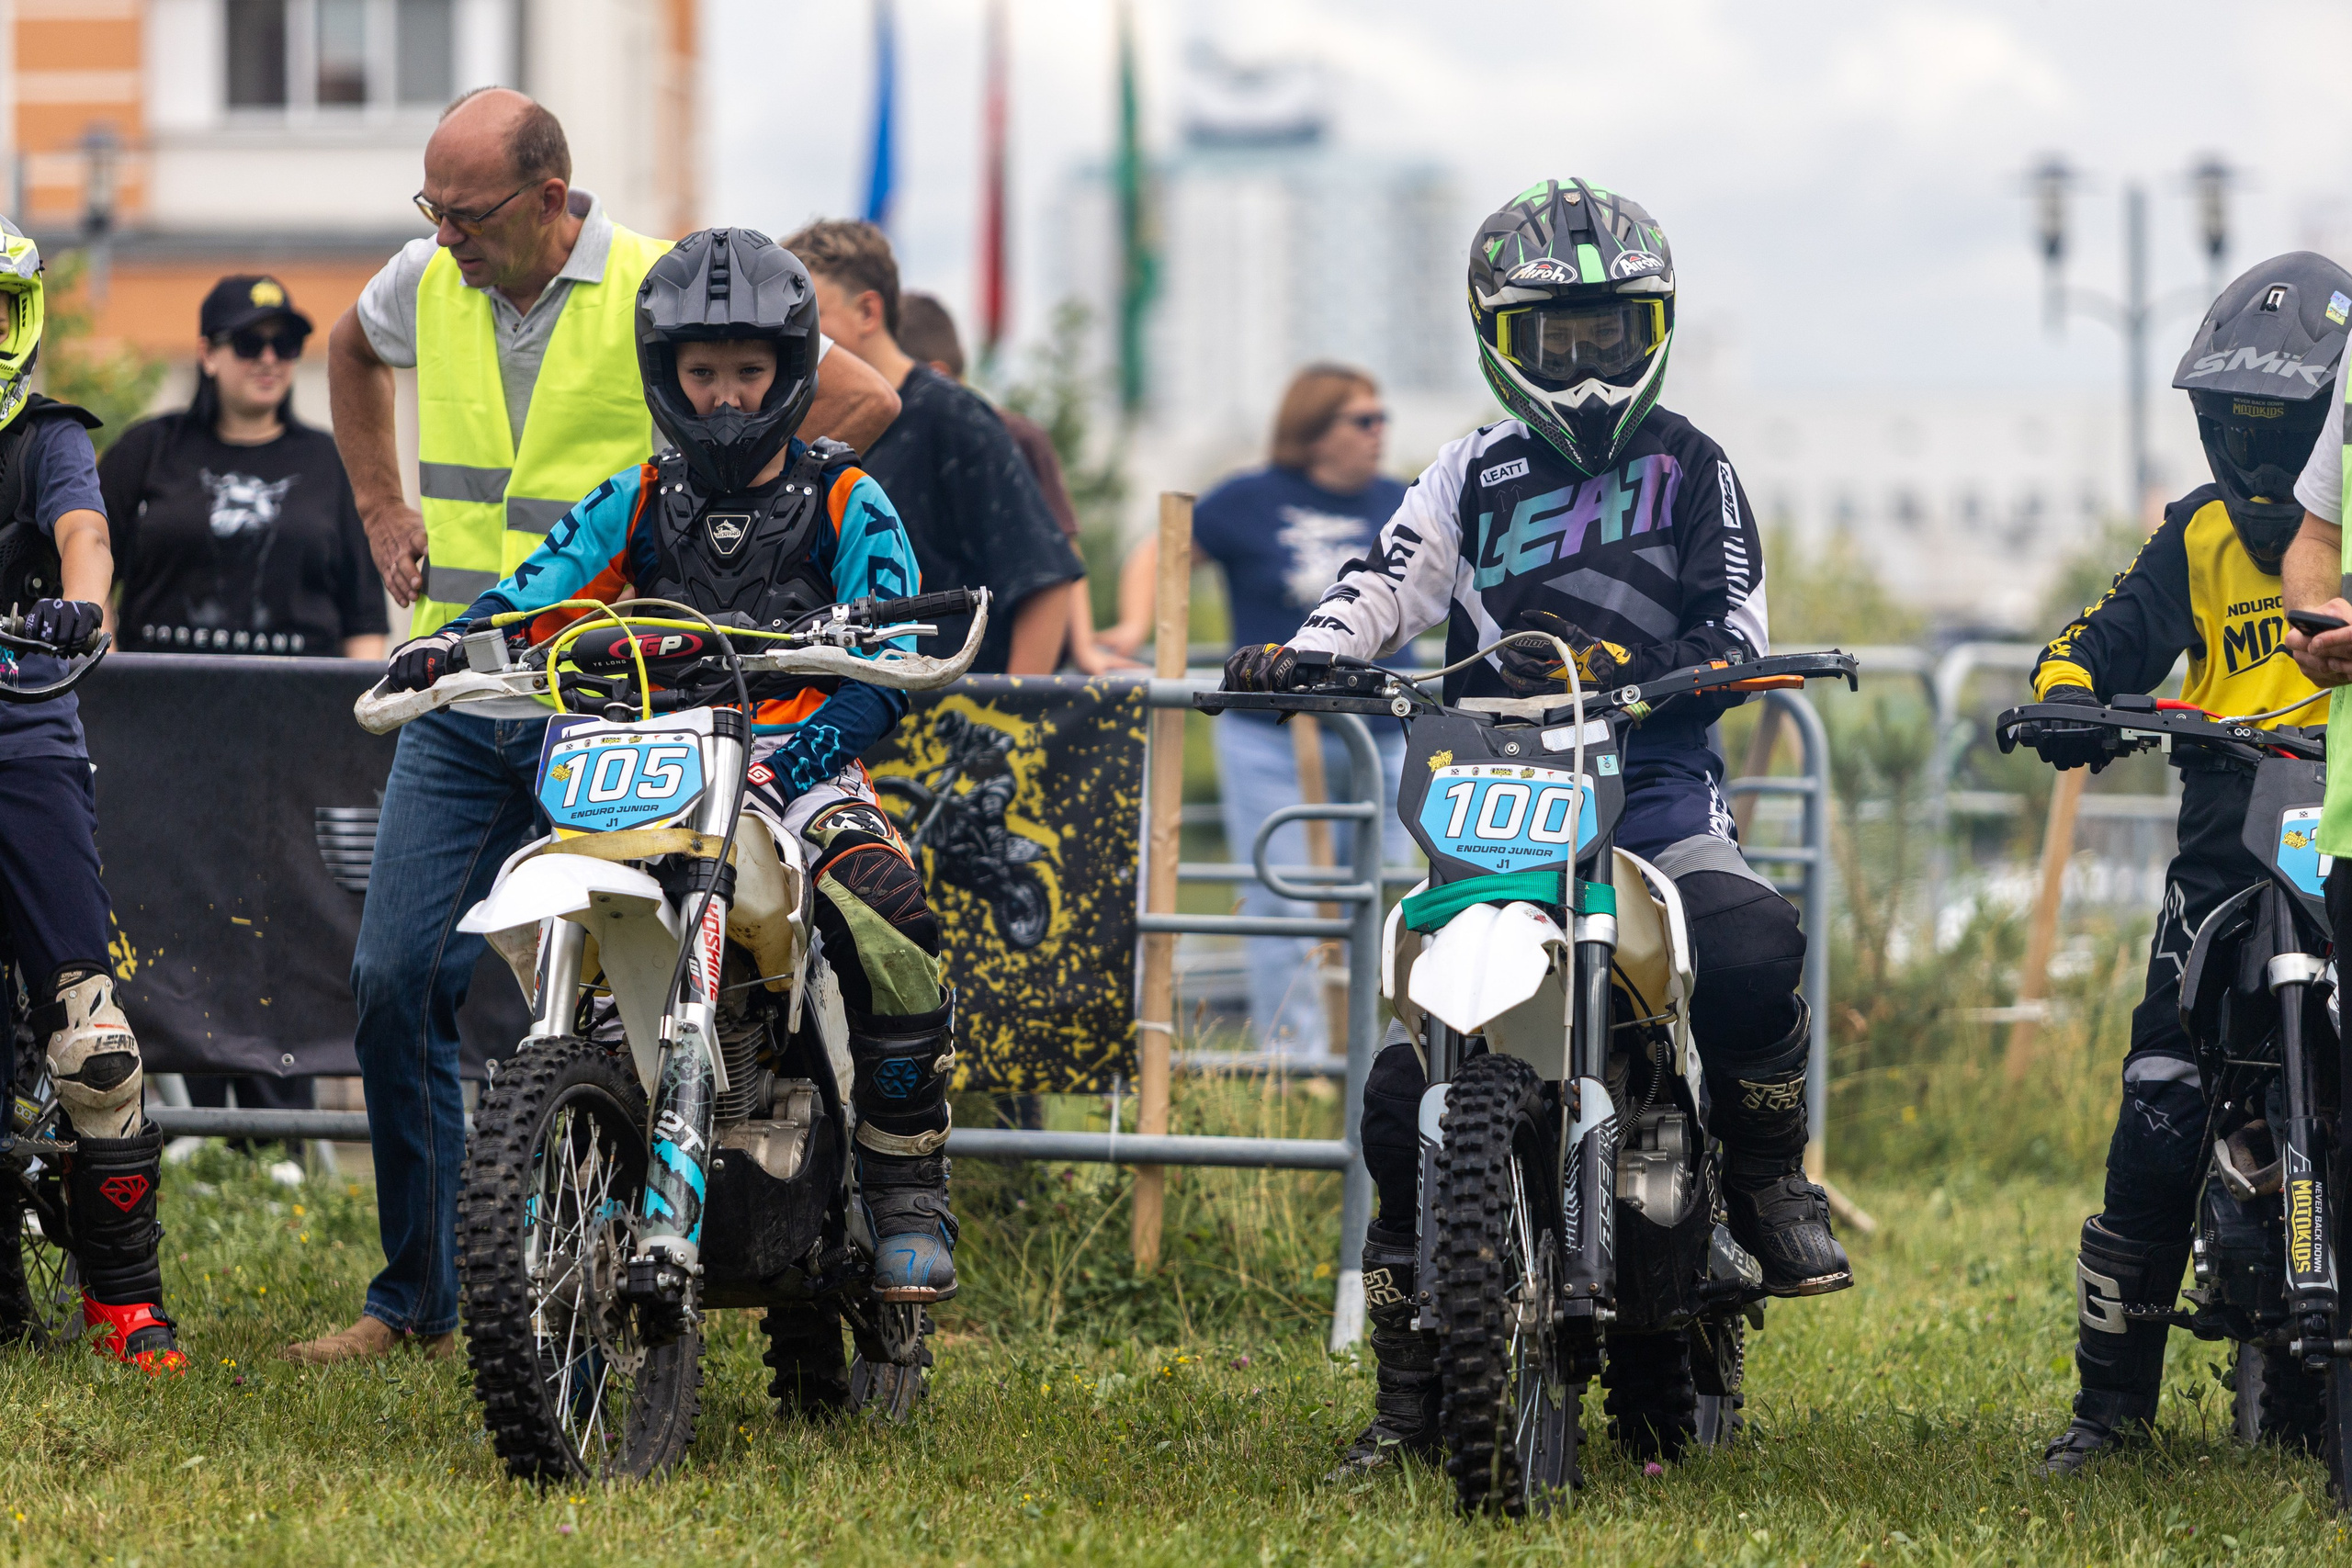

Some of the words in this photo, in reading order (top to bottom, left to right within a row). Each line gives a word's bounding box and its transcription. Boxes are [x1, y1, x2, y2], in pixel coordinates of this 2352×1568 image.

[1510, 263, 1566, 282] Airoh
[1619, 254, 1663, 276] Airoh
[2233, 403, 2284, 417] MOTOKIDS
[1482, 460, 1523, 483] LEATT
[2226, 595, 2283, 618] NDURO
[561, 746, 689, 808] 105
[570, 807, 615, 819] ENDURO
[616, 805, 660, 813] JUNIOR
[605, 818, 619, 828] J1
[1444, 781, 1586, 844] 100
[1456, 844, 1507, 854] ENDURO
[1508, 847, 1554, 857] JUNIOR
[1496, 858, 1510, 869] J1
[2314, 1181, 2323, 1213] NEVER
[2291, 1179, 2312, 1274] MOTOKIDS
[2314, 1216, 2323, 1241] BACK
[2313, 1243, 2323, 1273] DOWN
